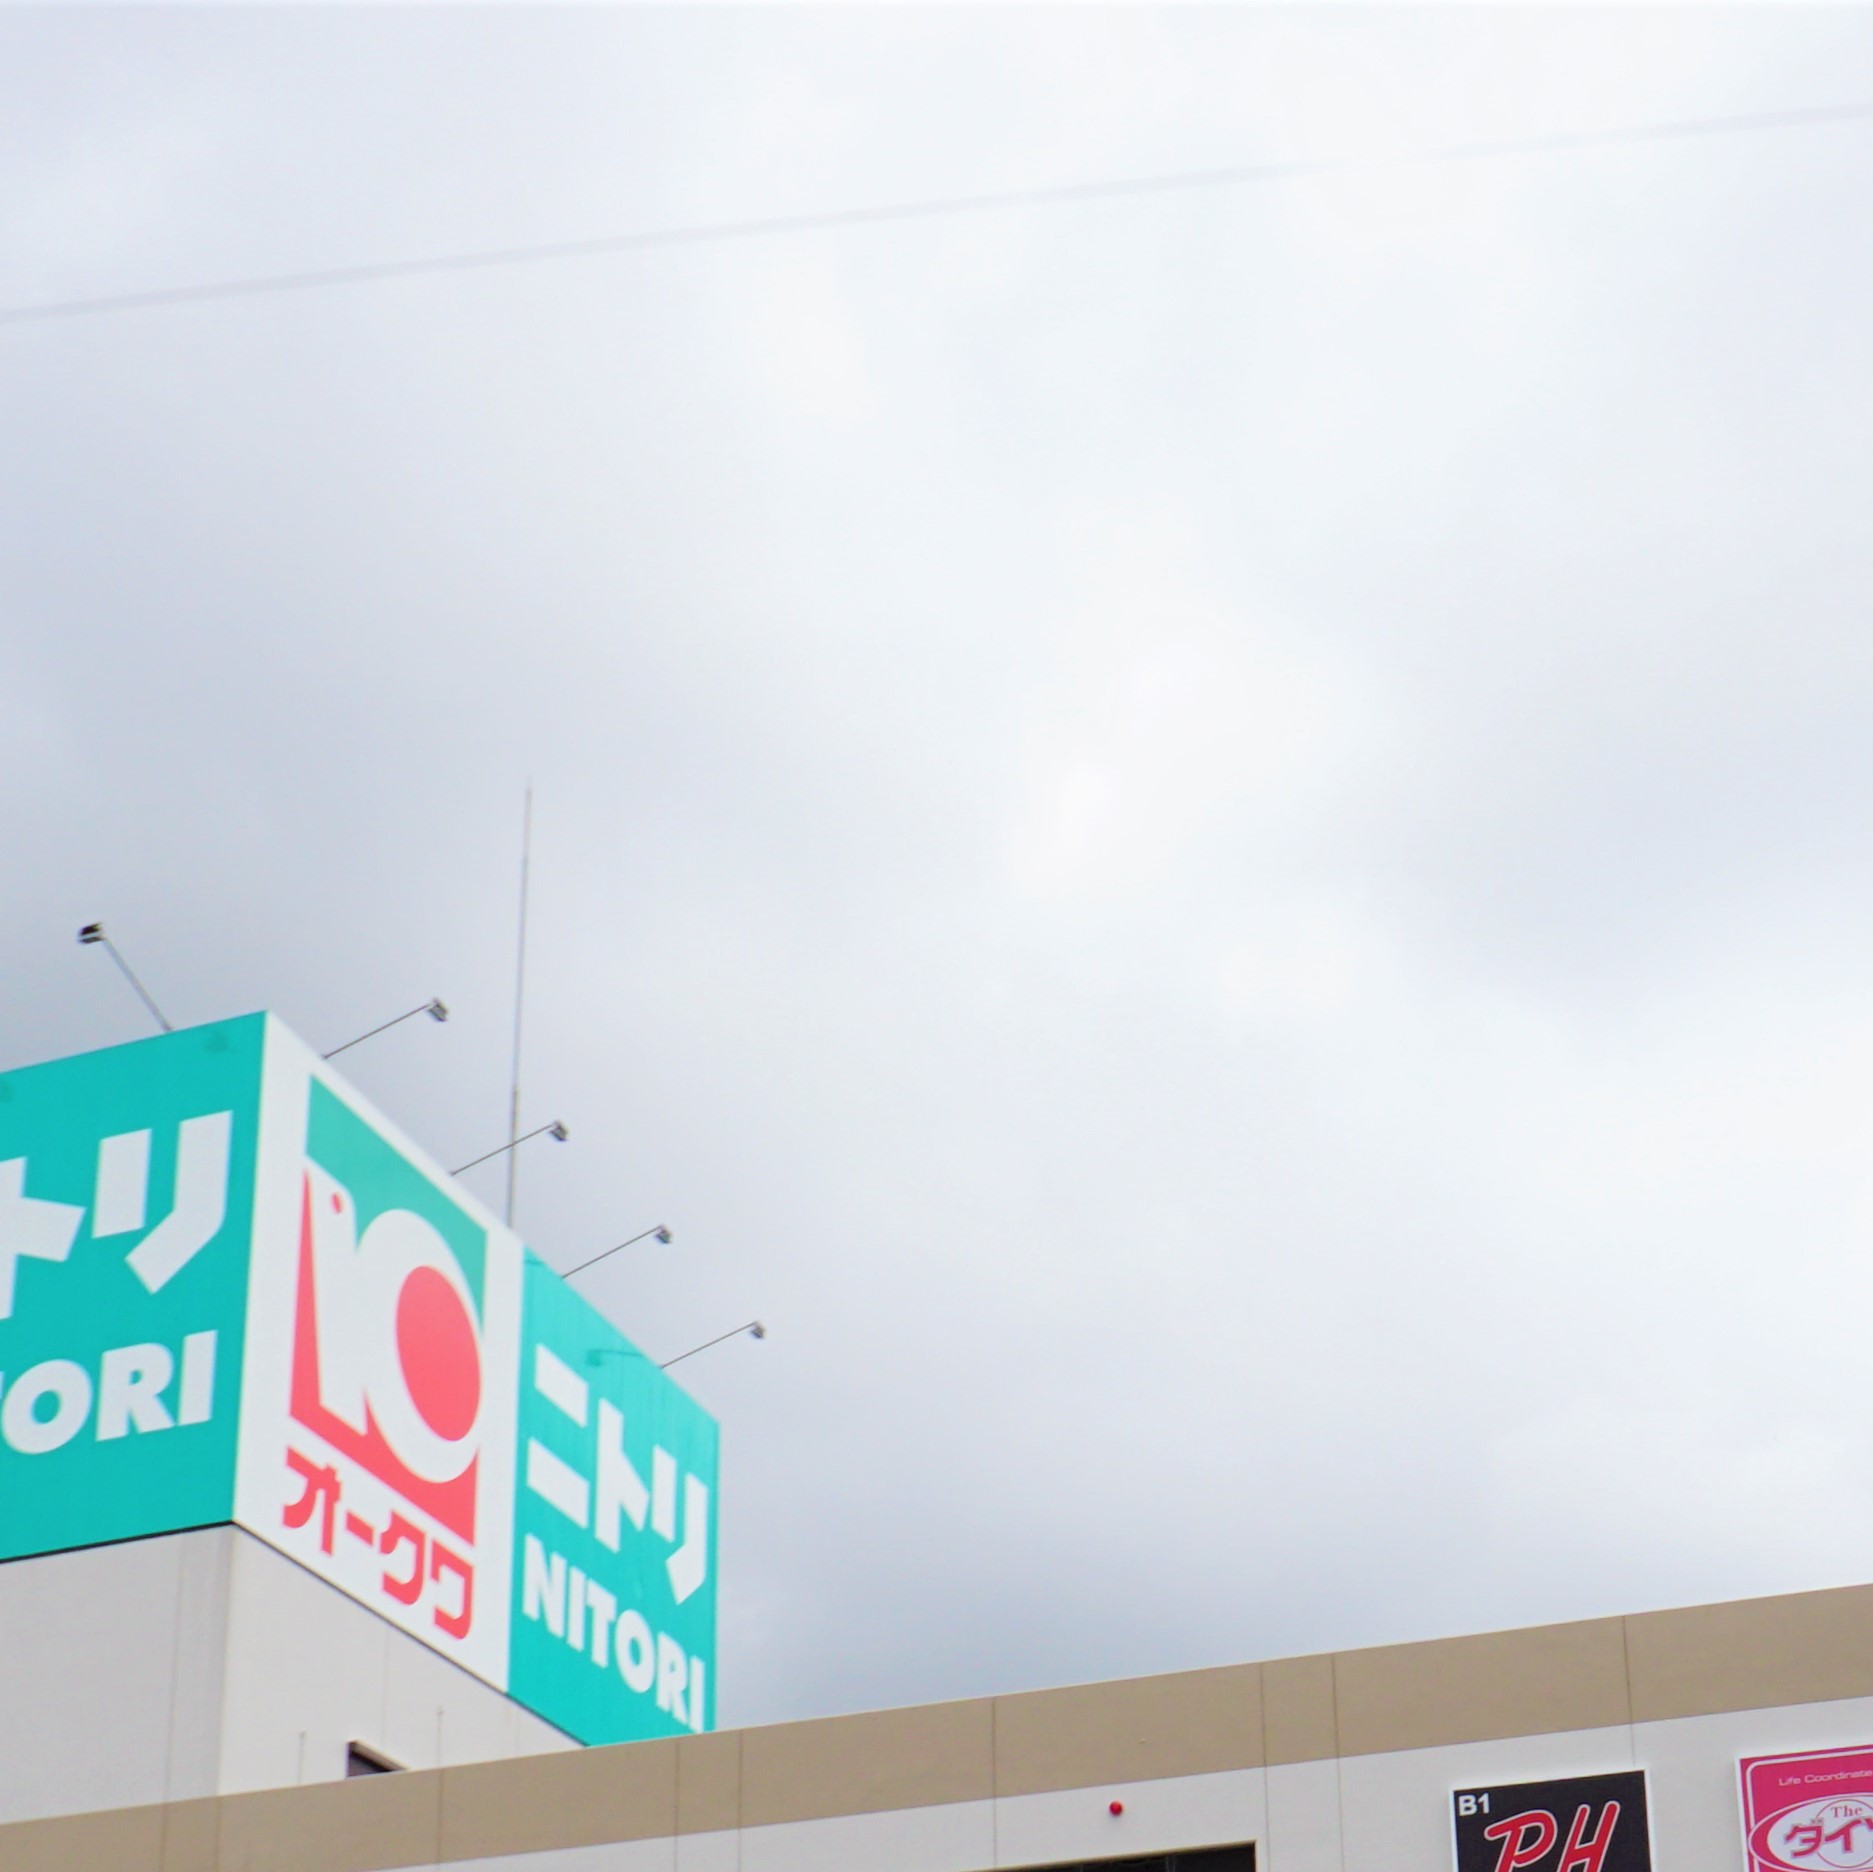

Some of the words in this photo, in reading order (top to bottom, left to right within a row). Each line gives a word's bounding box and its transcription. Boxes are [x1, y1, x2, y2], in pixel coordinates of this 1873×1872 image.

[527, 1343, 708, 1605] ニトリ
[283, 1445, 474, 1642] オークワ
[523, 1533, 705, 1734] NITORI
[1459, 1793, 1490, 1816] B1
[1779, 1777, 1801, 1787] Life
[1804, 1769, 1873, 1785] Coordinate
[1830, 1805, 1864, 1818] The
